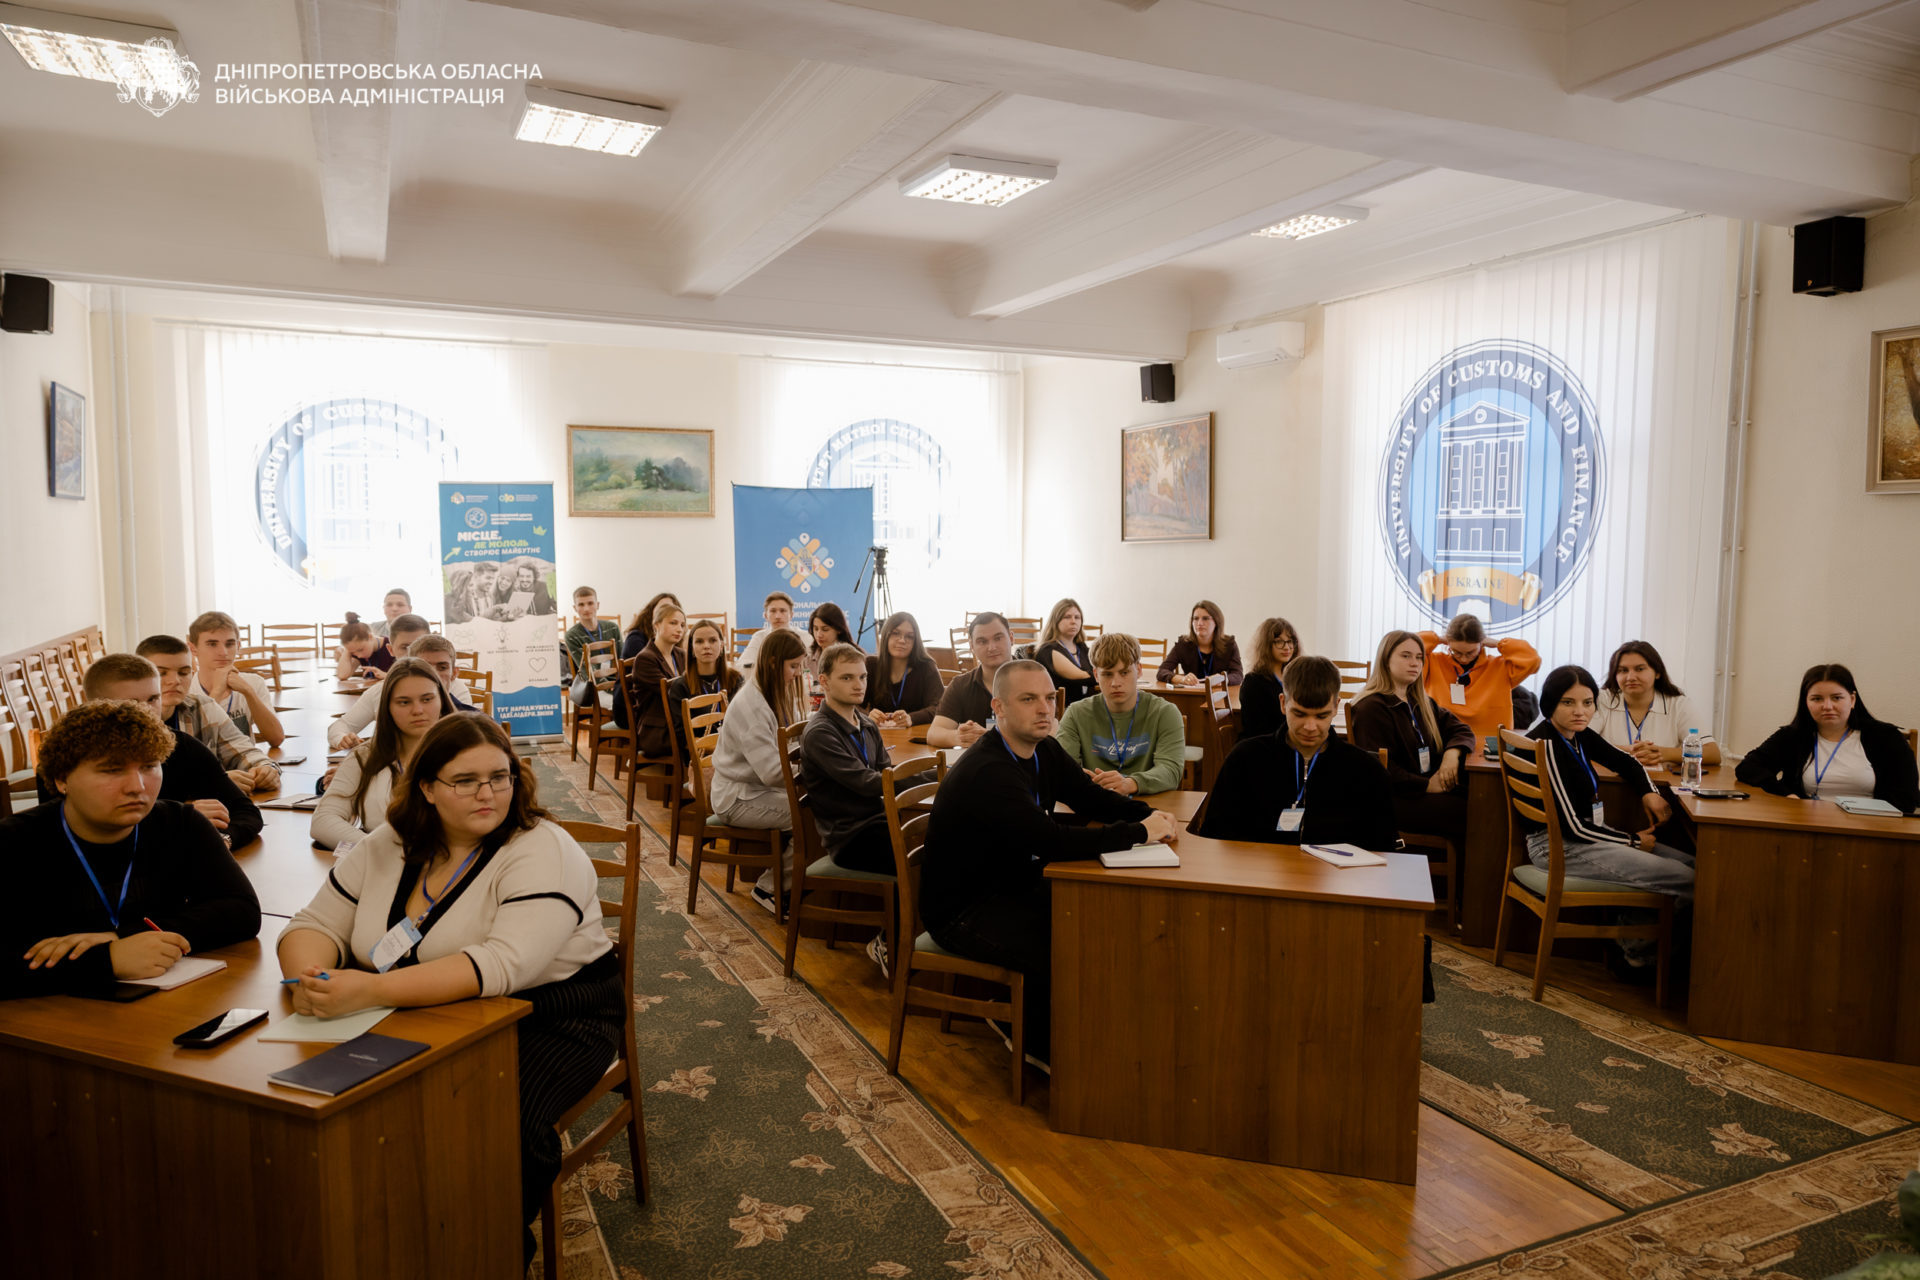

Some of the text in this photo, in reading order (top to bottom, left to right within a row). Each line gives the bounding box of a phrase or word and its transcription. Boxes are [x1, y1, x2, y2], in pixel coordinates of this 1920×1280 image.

[1390, 359, 1590, 564] UNIVERSITY OF CUSTOMS AND FINANCE
[1446, 576, 1505, 591] UKRAINE
